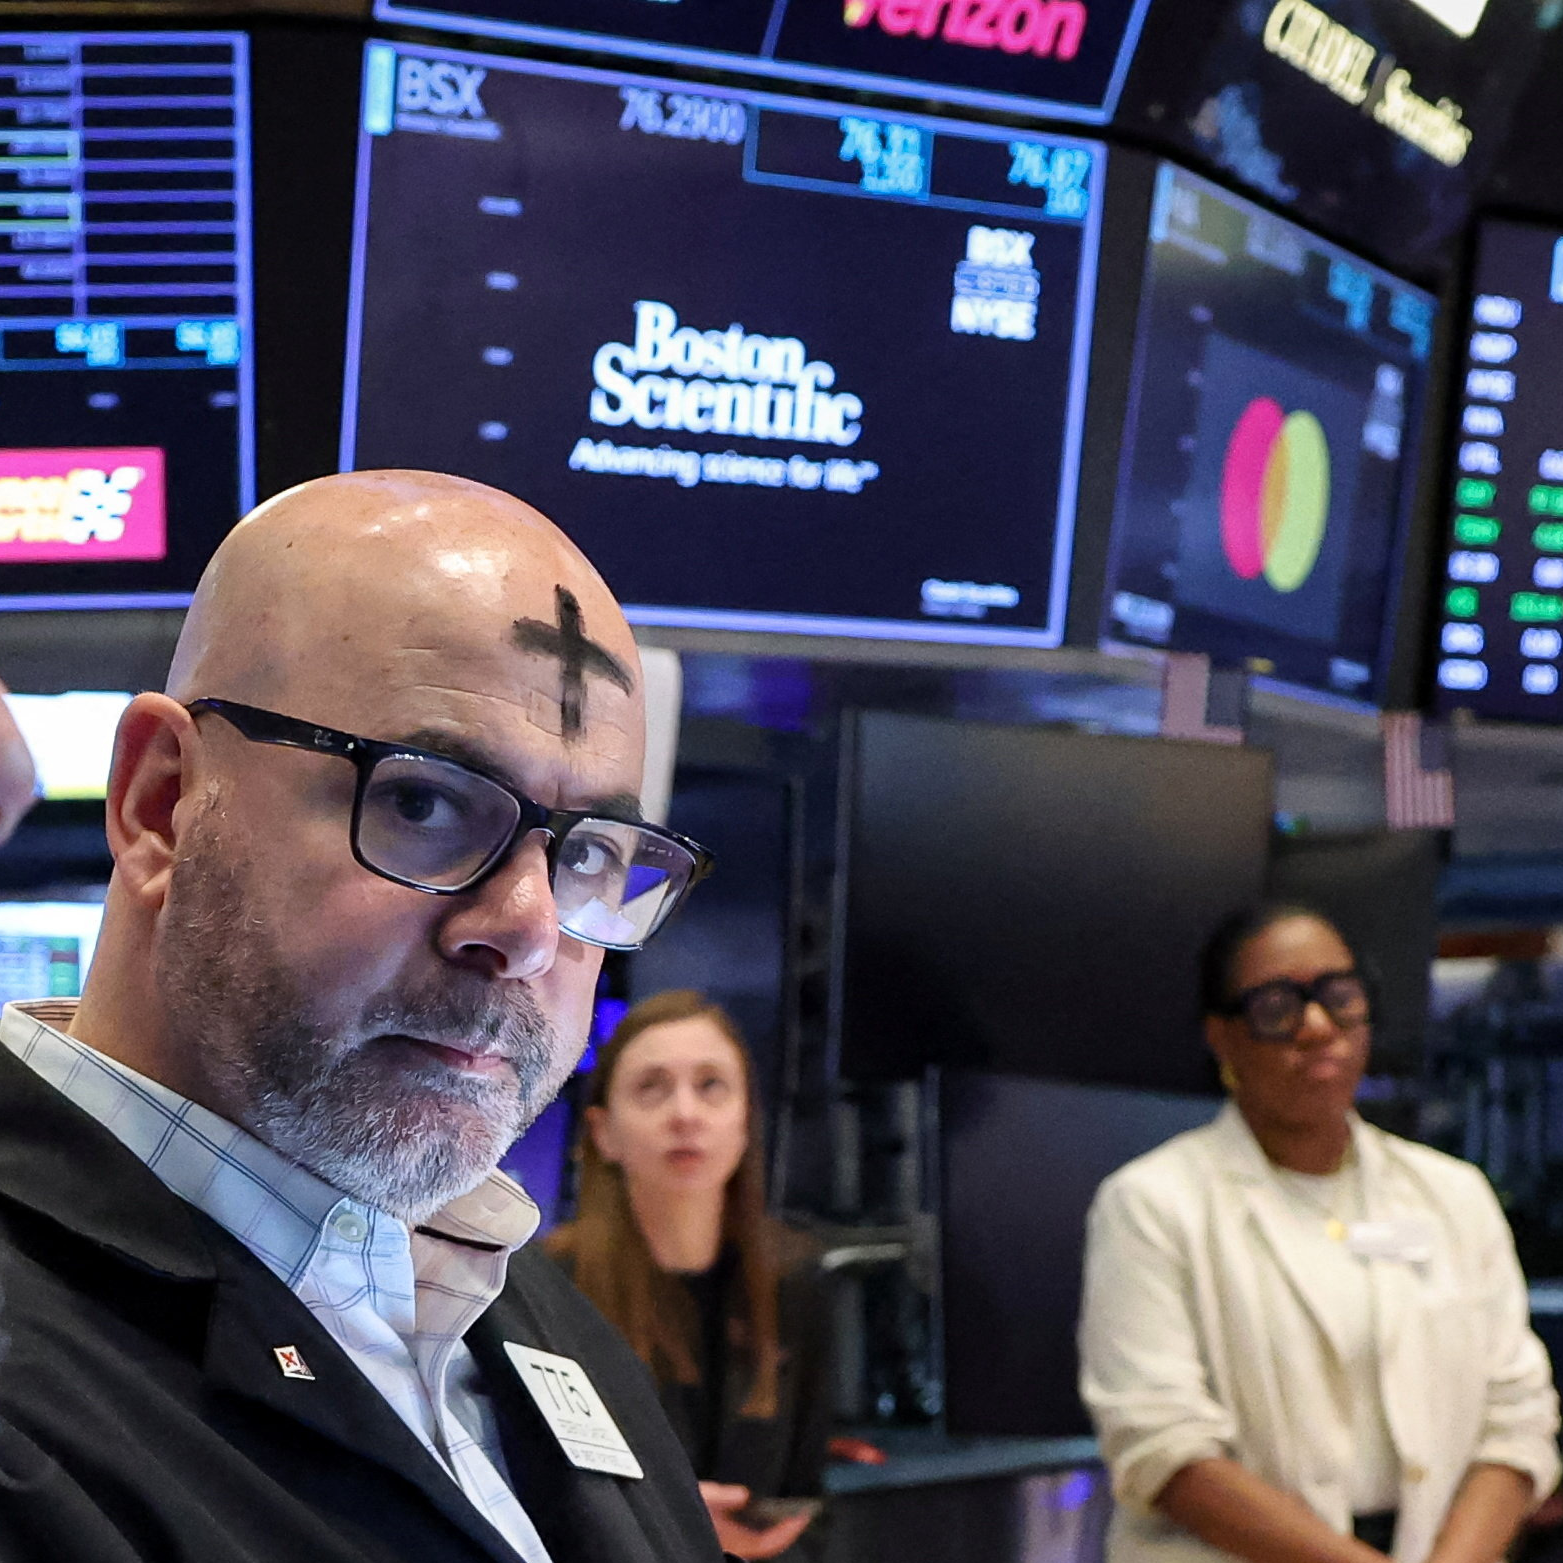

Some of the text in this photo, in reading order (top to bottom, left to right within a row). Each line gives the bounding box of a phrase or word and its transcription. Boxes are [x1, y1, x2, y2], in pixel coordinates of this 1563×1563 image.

[397, 57, 488, 118] BSX
[633, 300, 806, 384] Boston
[590, 342, 864, 446] Scientific
[530, 1362, 592, 1418] 775
